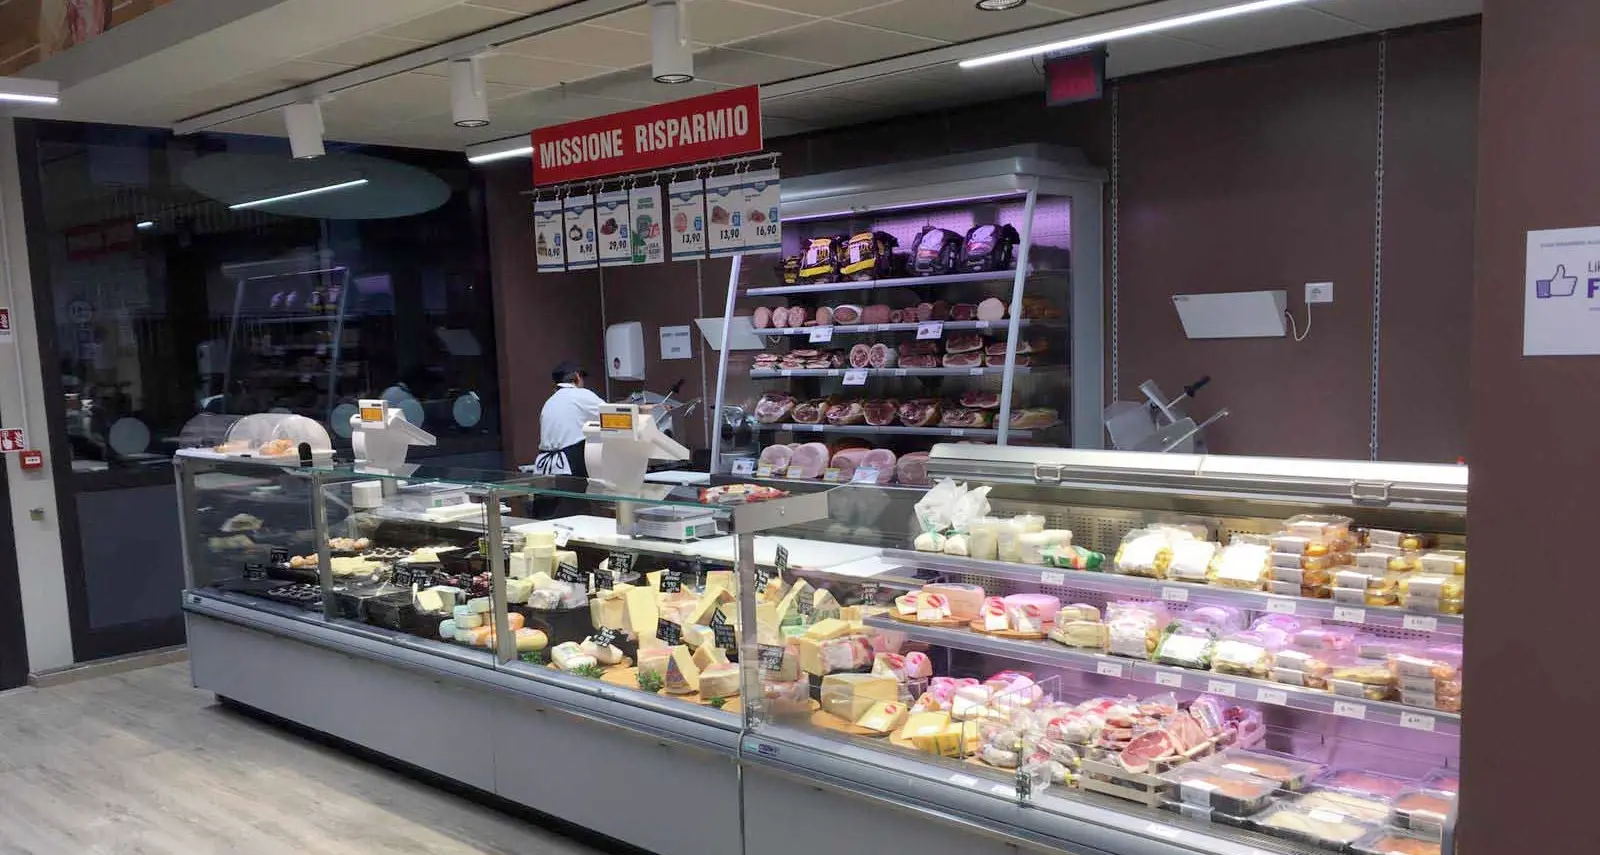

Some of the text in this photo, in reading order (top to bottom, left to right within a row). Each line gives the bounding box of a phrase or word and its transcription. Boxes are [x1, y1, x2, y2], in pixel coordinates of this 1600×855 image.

[540, 105, 748, 169] MISSIONE RISPARMIO
[720, 229, 740, 241] 13,90
[756, 224, 777, 237] 16,90
[682, 233, 701, 244] 13,90
[609, 240, 627, 251] 29,90
